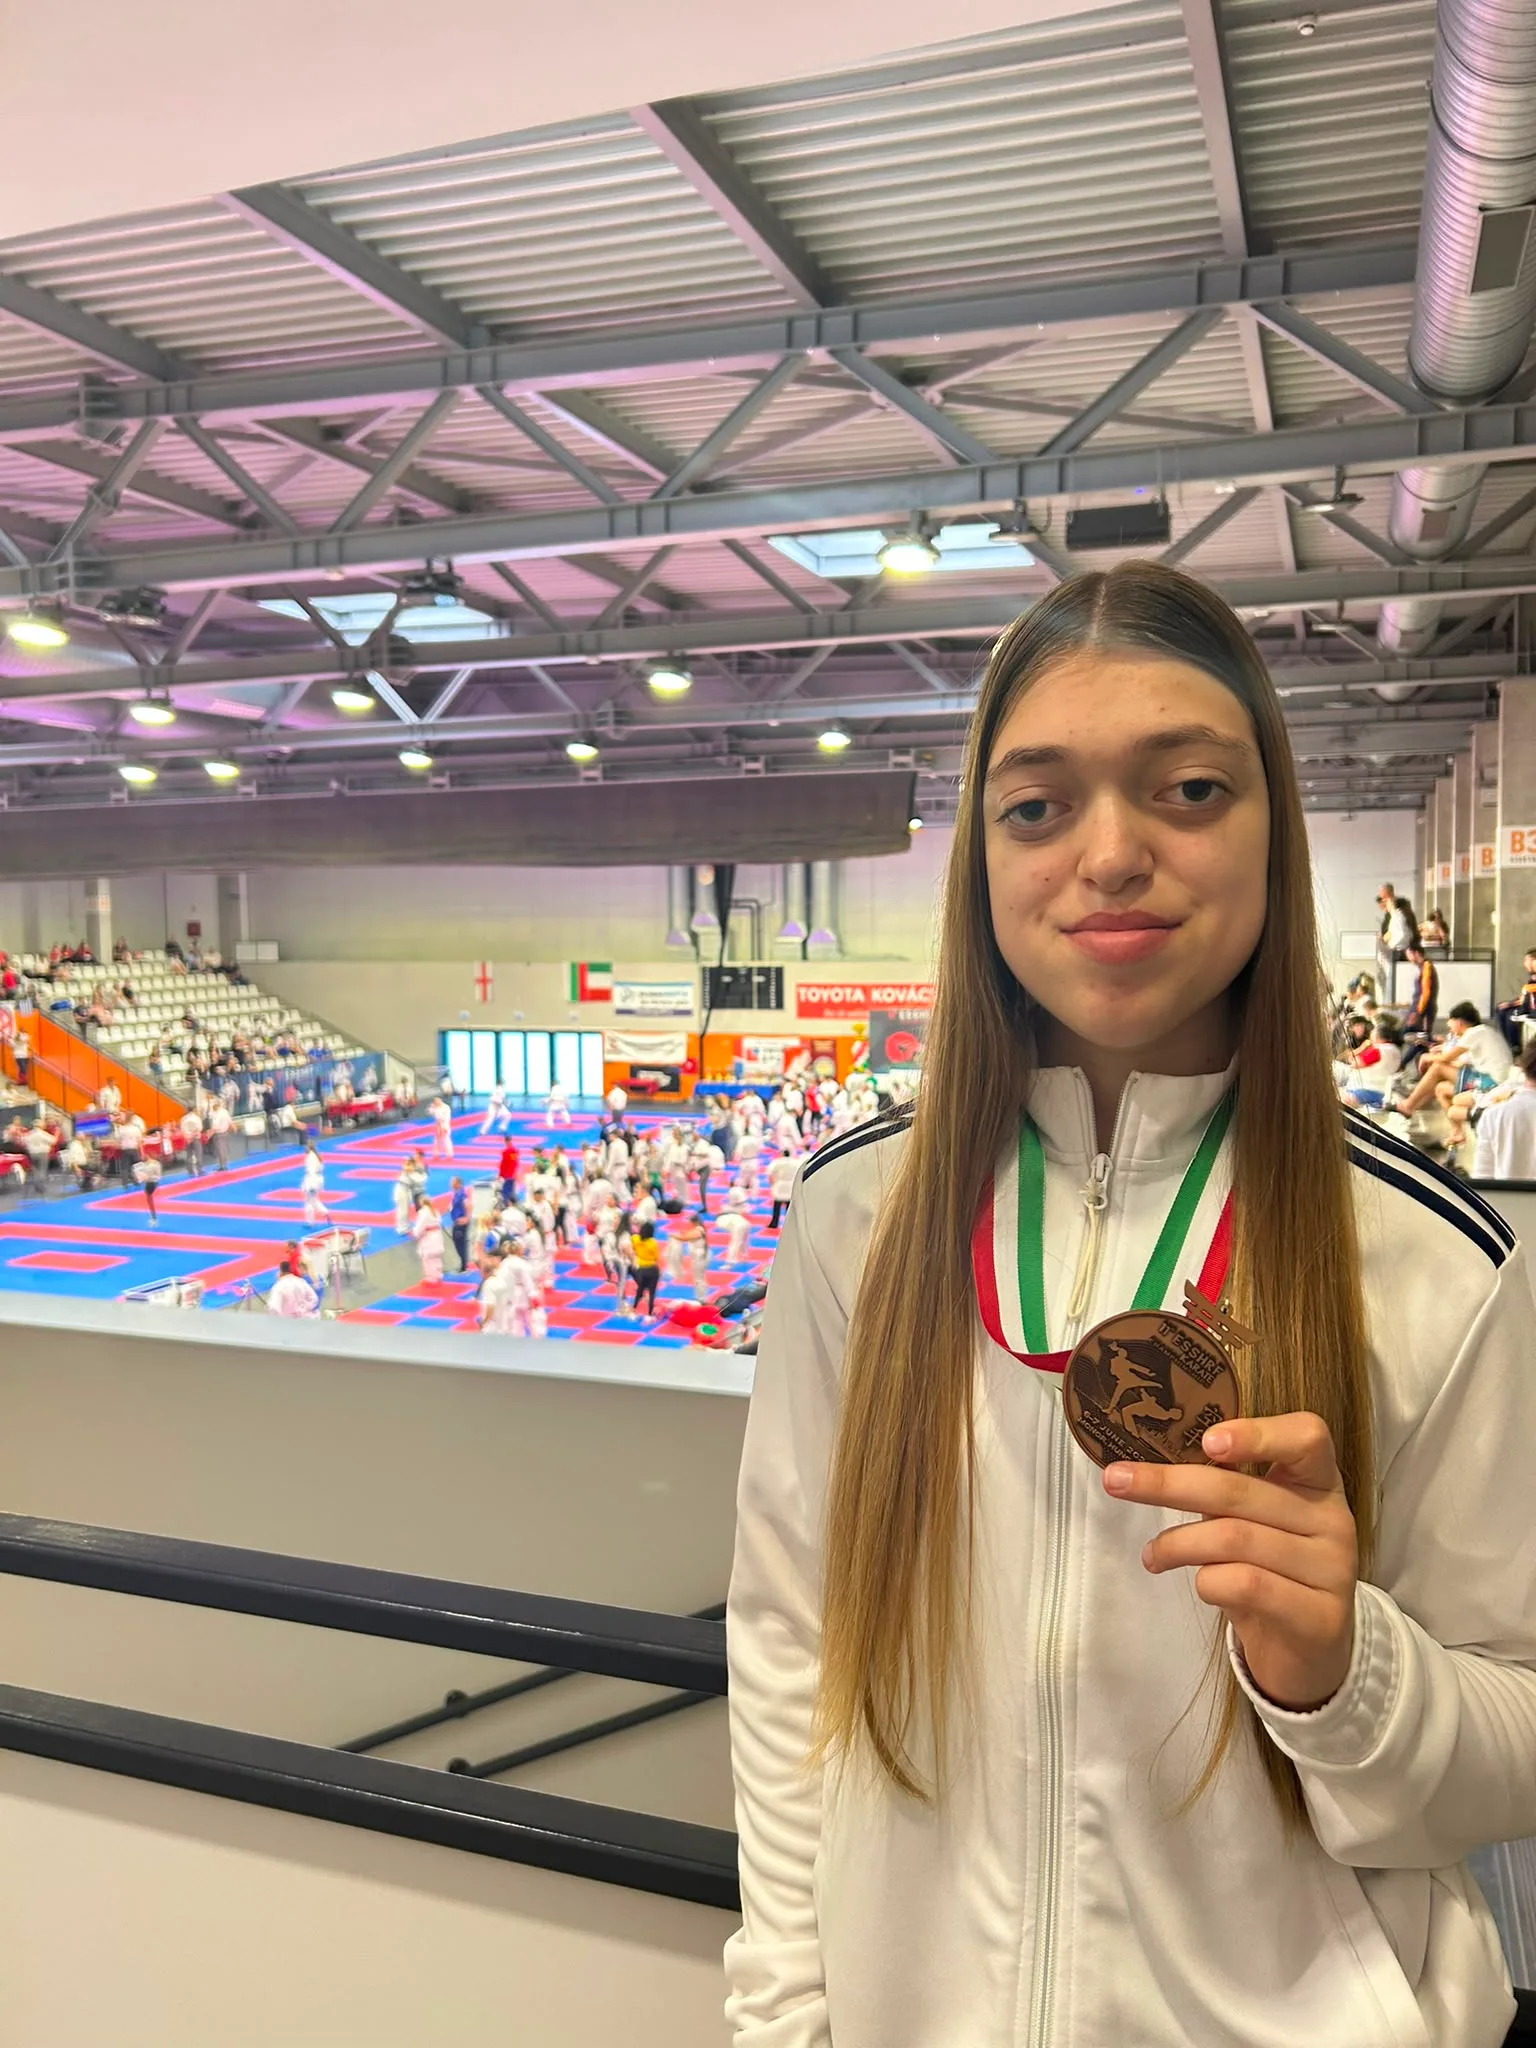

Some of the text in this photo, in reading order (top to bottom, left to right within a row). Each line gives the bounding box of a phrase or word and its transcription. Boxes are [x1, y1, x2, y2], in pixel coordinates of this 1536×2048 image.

[799, 983, 933, 1002] TOYOTA KOVÁC
[1172, 1334, 1225, 1375] ESSHRF
[1180, 1353, 1215, 1383] KARATE
[1099, 1425, 1126, 1448] JUNE
[1126, 1446, 1146, 1462] 202
[1107, 1441, 1132, 1460] HUNG
